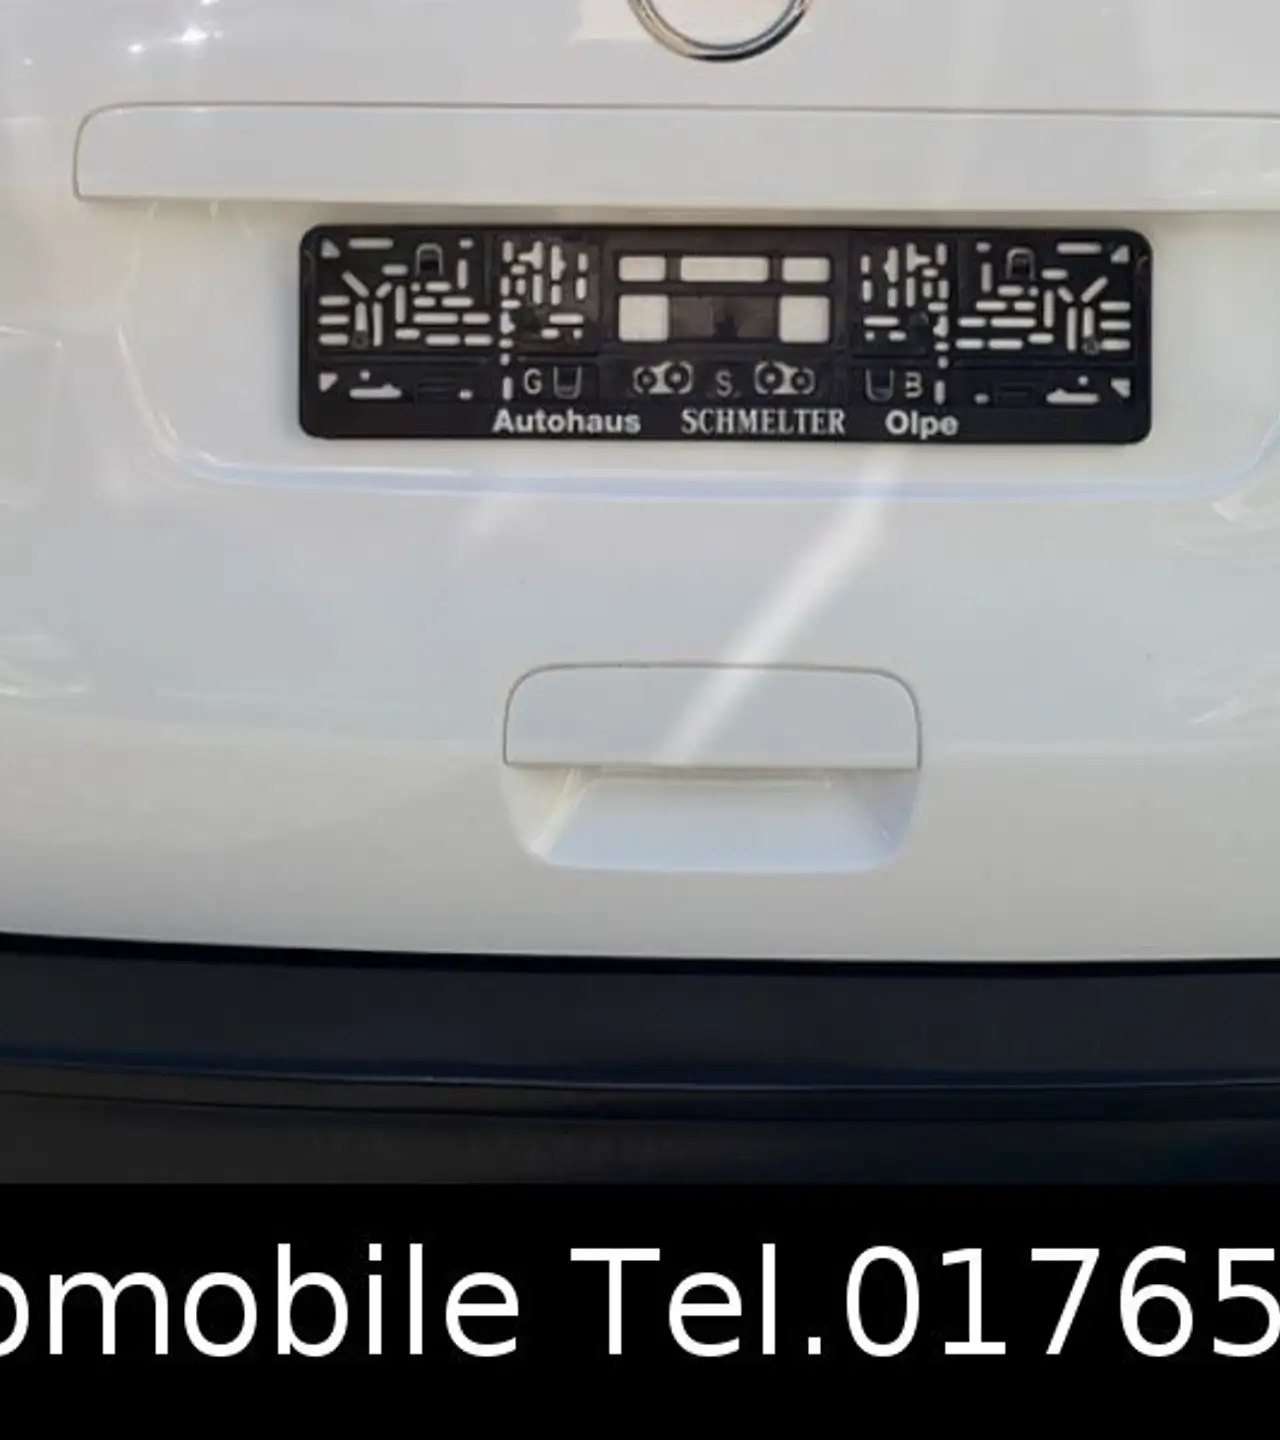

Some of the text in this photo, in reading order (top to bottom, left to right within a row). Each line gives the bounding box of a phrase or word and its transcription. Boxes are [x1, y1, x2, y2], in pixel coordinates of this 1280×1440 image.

[491, 408, 959, 440] Autohaus SCHMELTER Olpe
